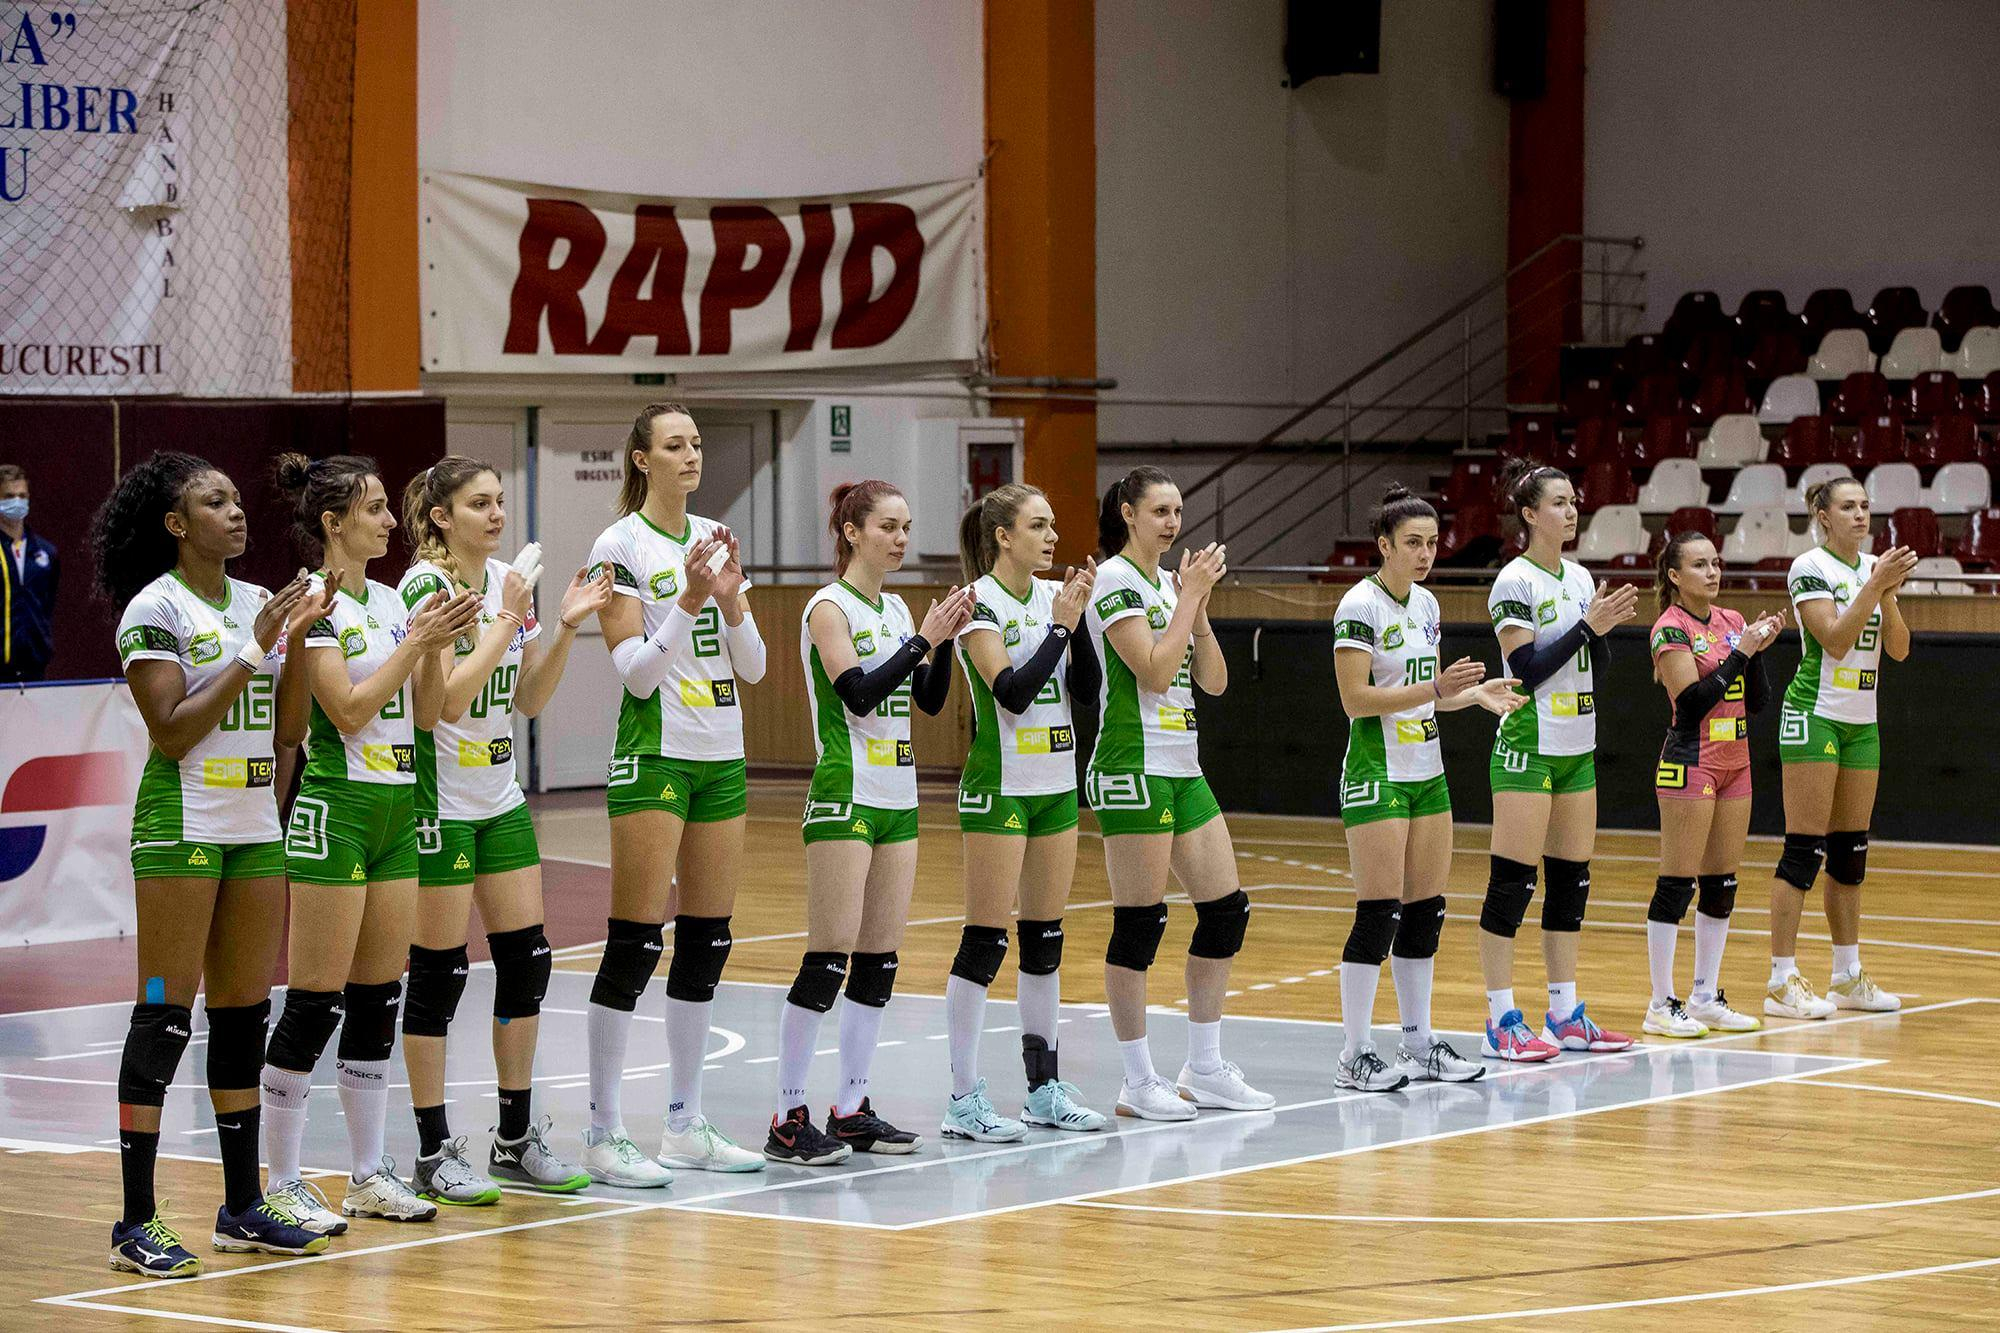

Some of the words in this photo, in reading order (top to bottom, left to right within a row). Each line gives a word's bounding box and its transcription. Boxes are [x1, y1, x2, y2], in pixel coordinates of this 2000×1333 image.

[0, 11, 76, 66] A”
[503, 198, 924, 356] RAPID
[121, 630, 143, 649] AIR
[344, 1067, 383, 1080] asics
